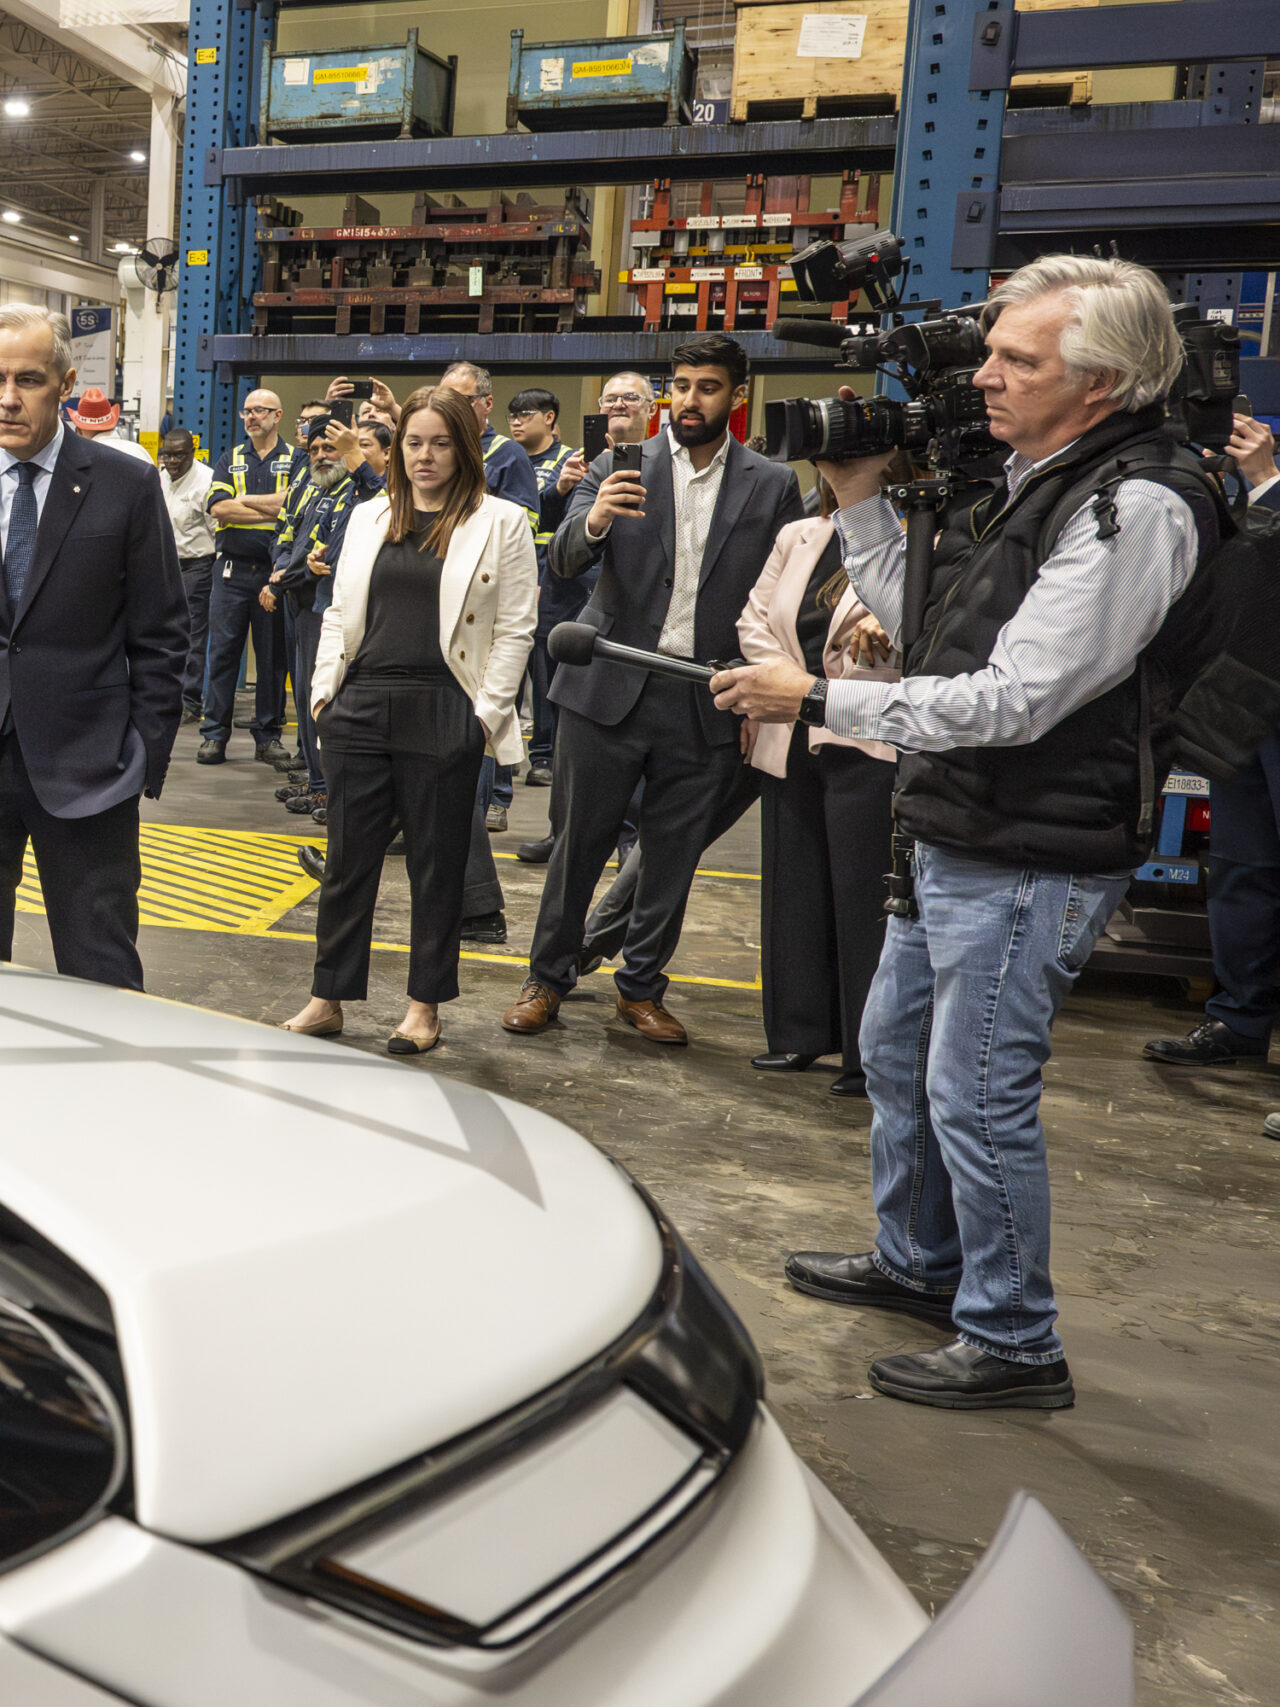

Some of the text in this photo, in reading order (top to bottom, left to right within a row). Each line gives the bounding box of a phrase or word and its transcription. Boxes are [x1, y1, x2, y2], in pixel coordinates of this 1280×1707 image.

[693, 103, 715, 122] 20
[189, 252, 207, 263] E-3
[738, 267, 759, 280] FRONT
[80, 314, 96, 326] 5S
[1168, 868, 1190, 881] M24
